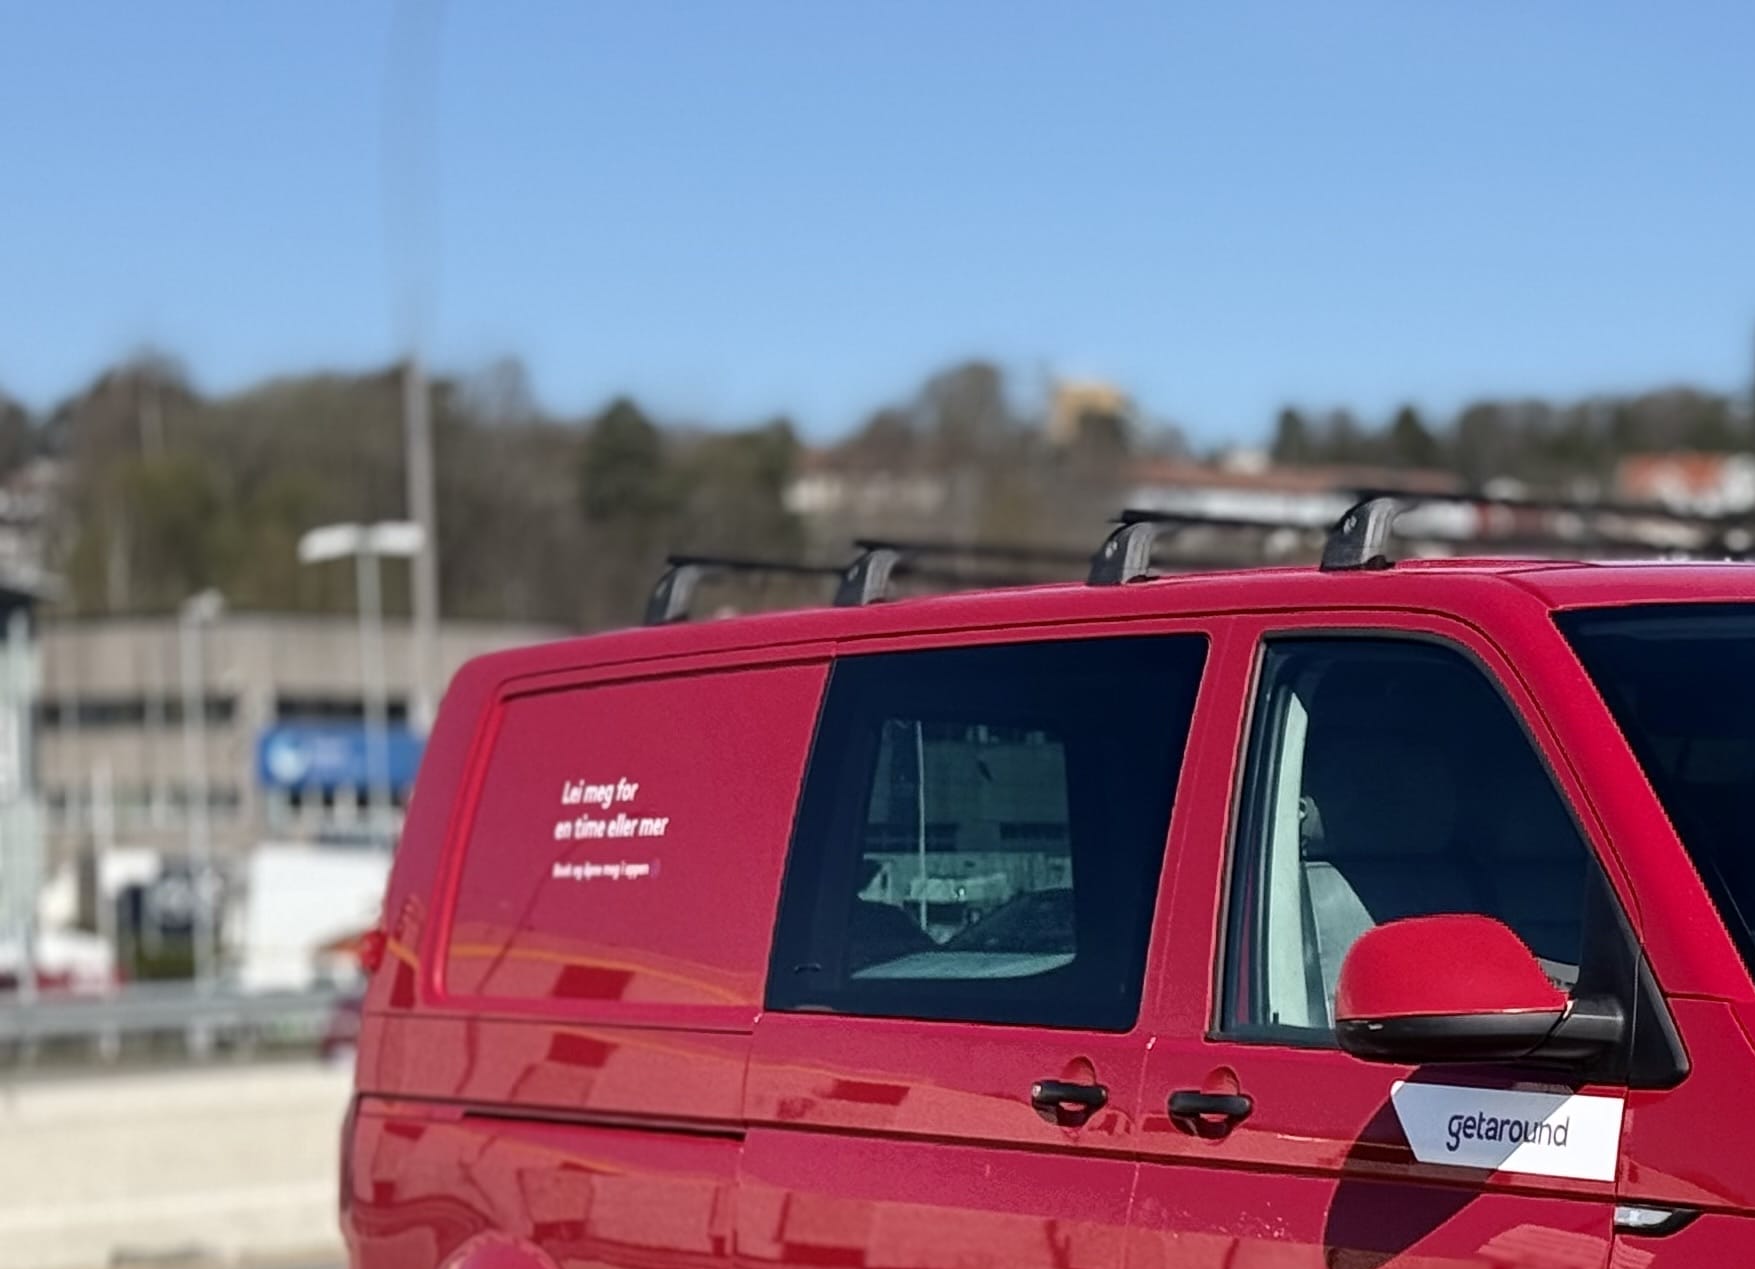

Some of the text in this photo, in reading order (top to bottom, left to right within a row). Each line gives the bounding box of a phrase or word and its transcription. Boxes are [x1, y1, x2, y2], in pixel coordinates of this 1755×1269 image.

[562, 776, 639, 810] Lei meg for
[554, 812, 669, 840] en time eller mer
[1446, 1111, 1570, 1151] getaround
